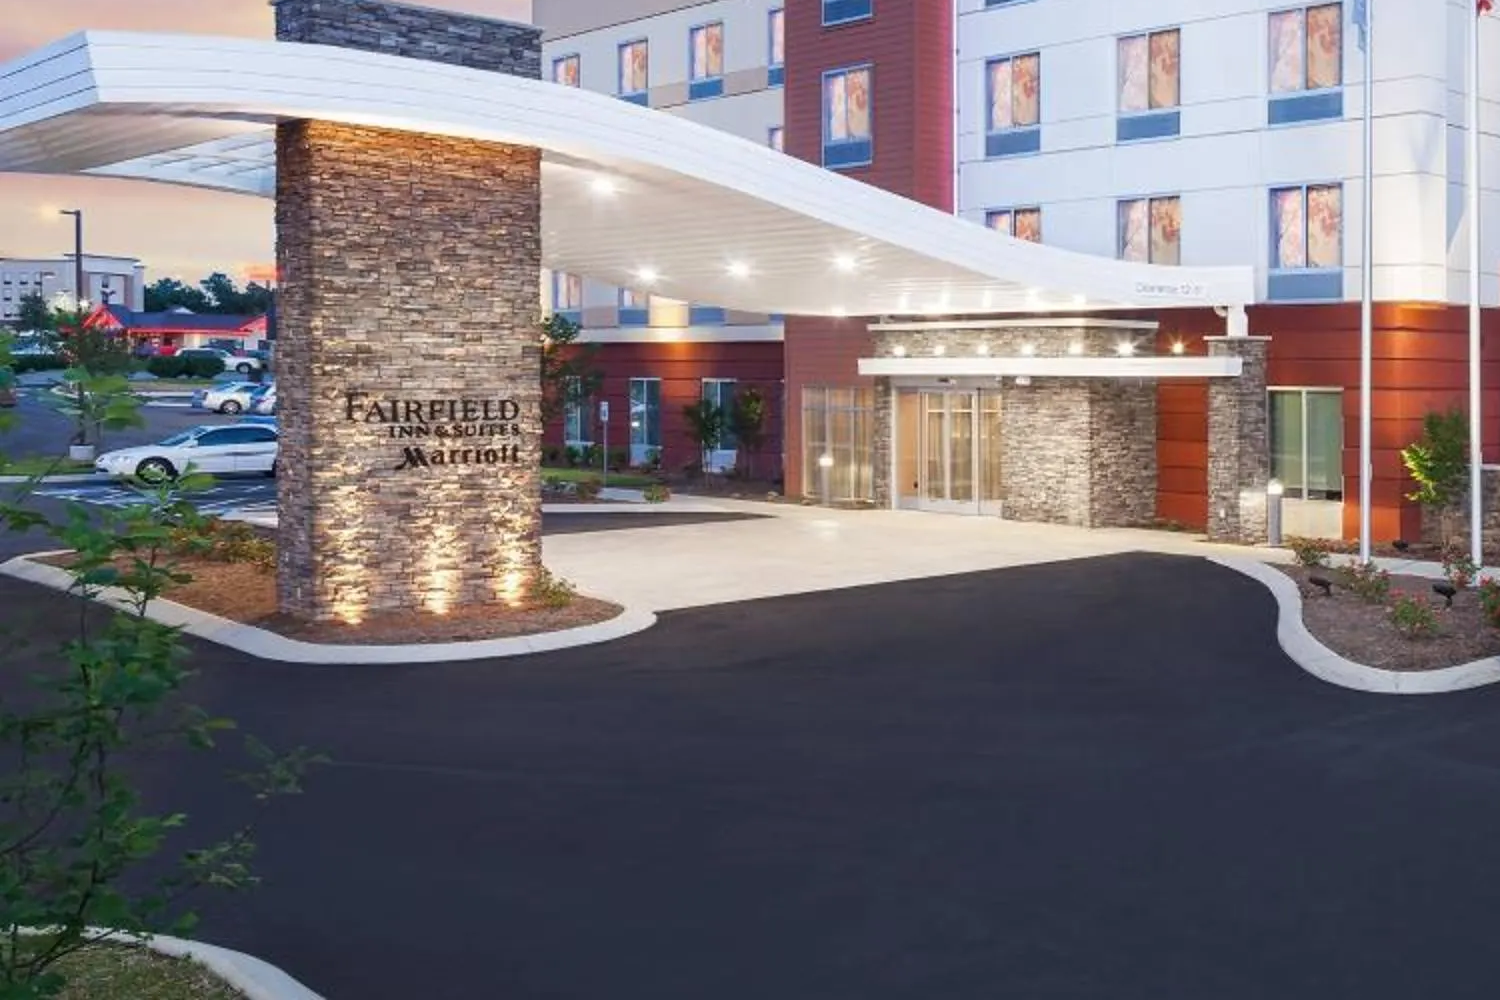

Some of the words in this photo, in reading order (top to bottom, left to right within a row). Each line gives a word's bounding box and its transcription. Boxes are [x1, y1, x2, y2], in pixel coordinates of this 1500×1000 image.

[345, 391, 520, 424] FAIRFIELD
[389, 424, 430, 438] INN
[452, 423, 520, 438] SUITES
[394, 443, 519, 471] Marriott
